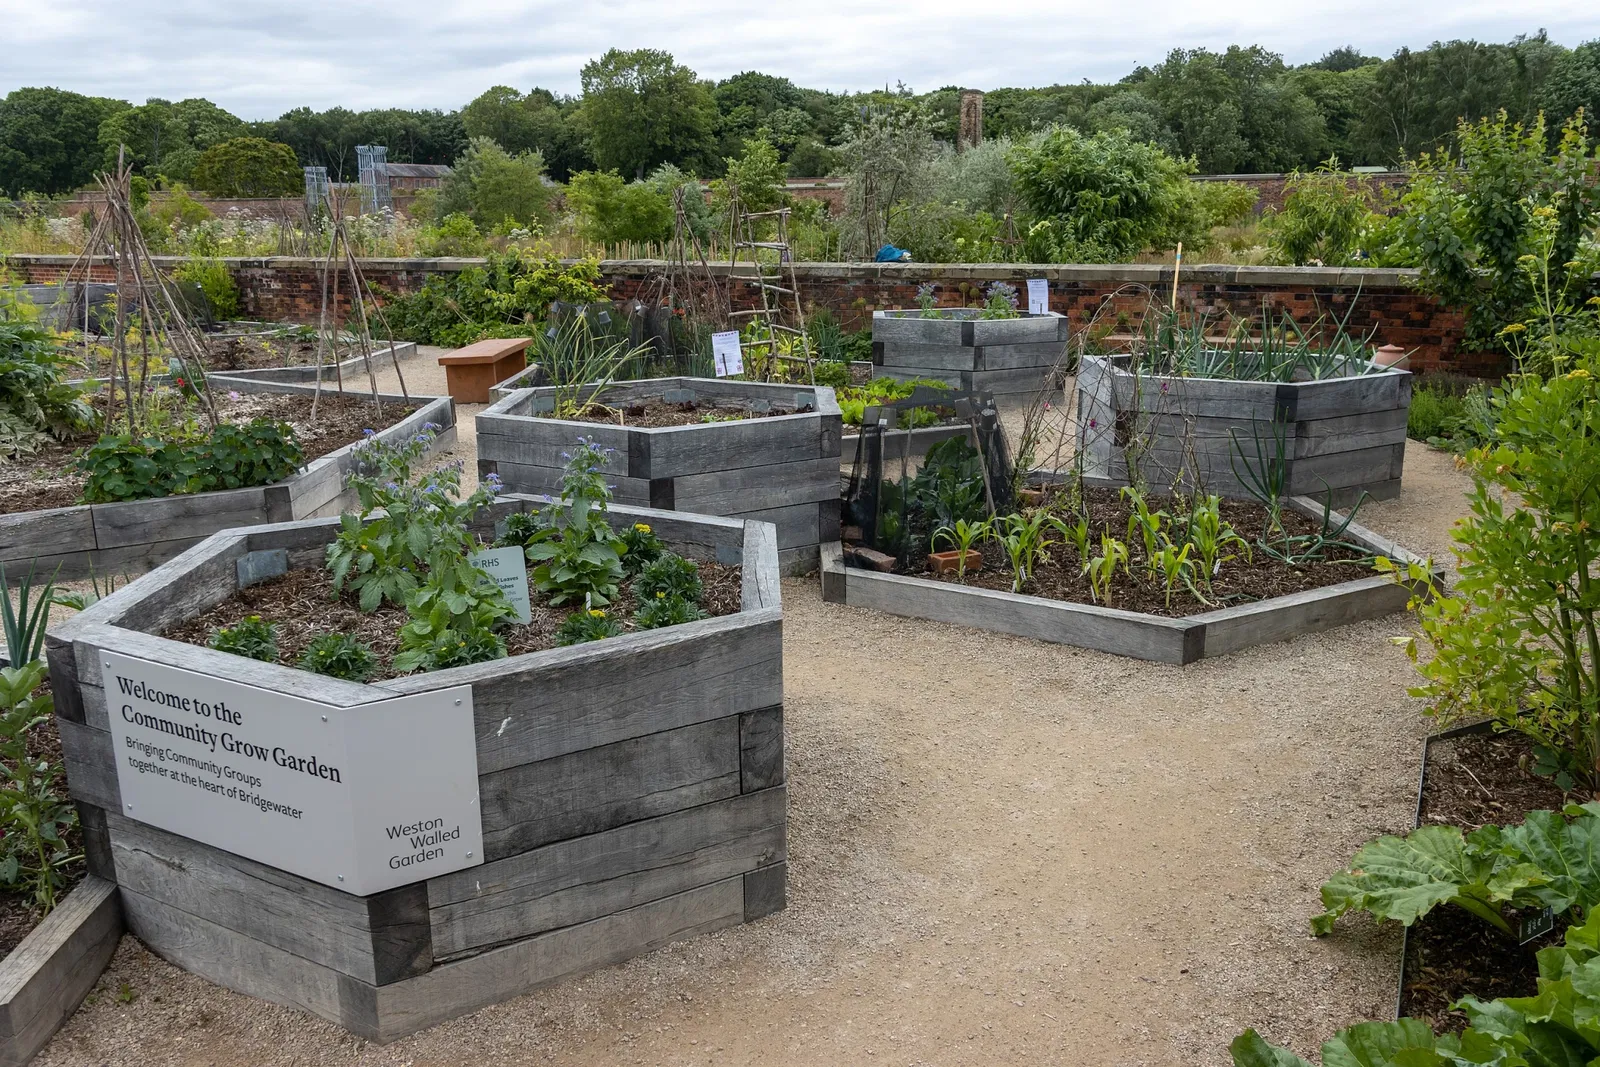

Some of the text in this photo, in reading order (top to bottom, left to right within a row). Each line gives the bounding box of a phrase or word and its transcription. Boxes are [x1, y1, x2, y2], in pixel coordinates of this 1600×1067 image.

[482, 558, 500, 568] RHS
[116, 676, 242, 726] Welcome to the
[122, 705, 342, 784] Community Grow Garden
[126, 736, 262, 789] Bringing Community Groups
[128, 756, 303, 820] together at the heart of Bridgewater
[386, 818, 443, 840] Weston
[410, 825, 460, 849] Walled
[389, 848, 444, 870] Garden
